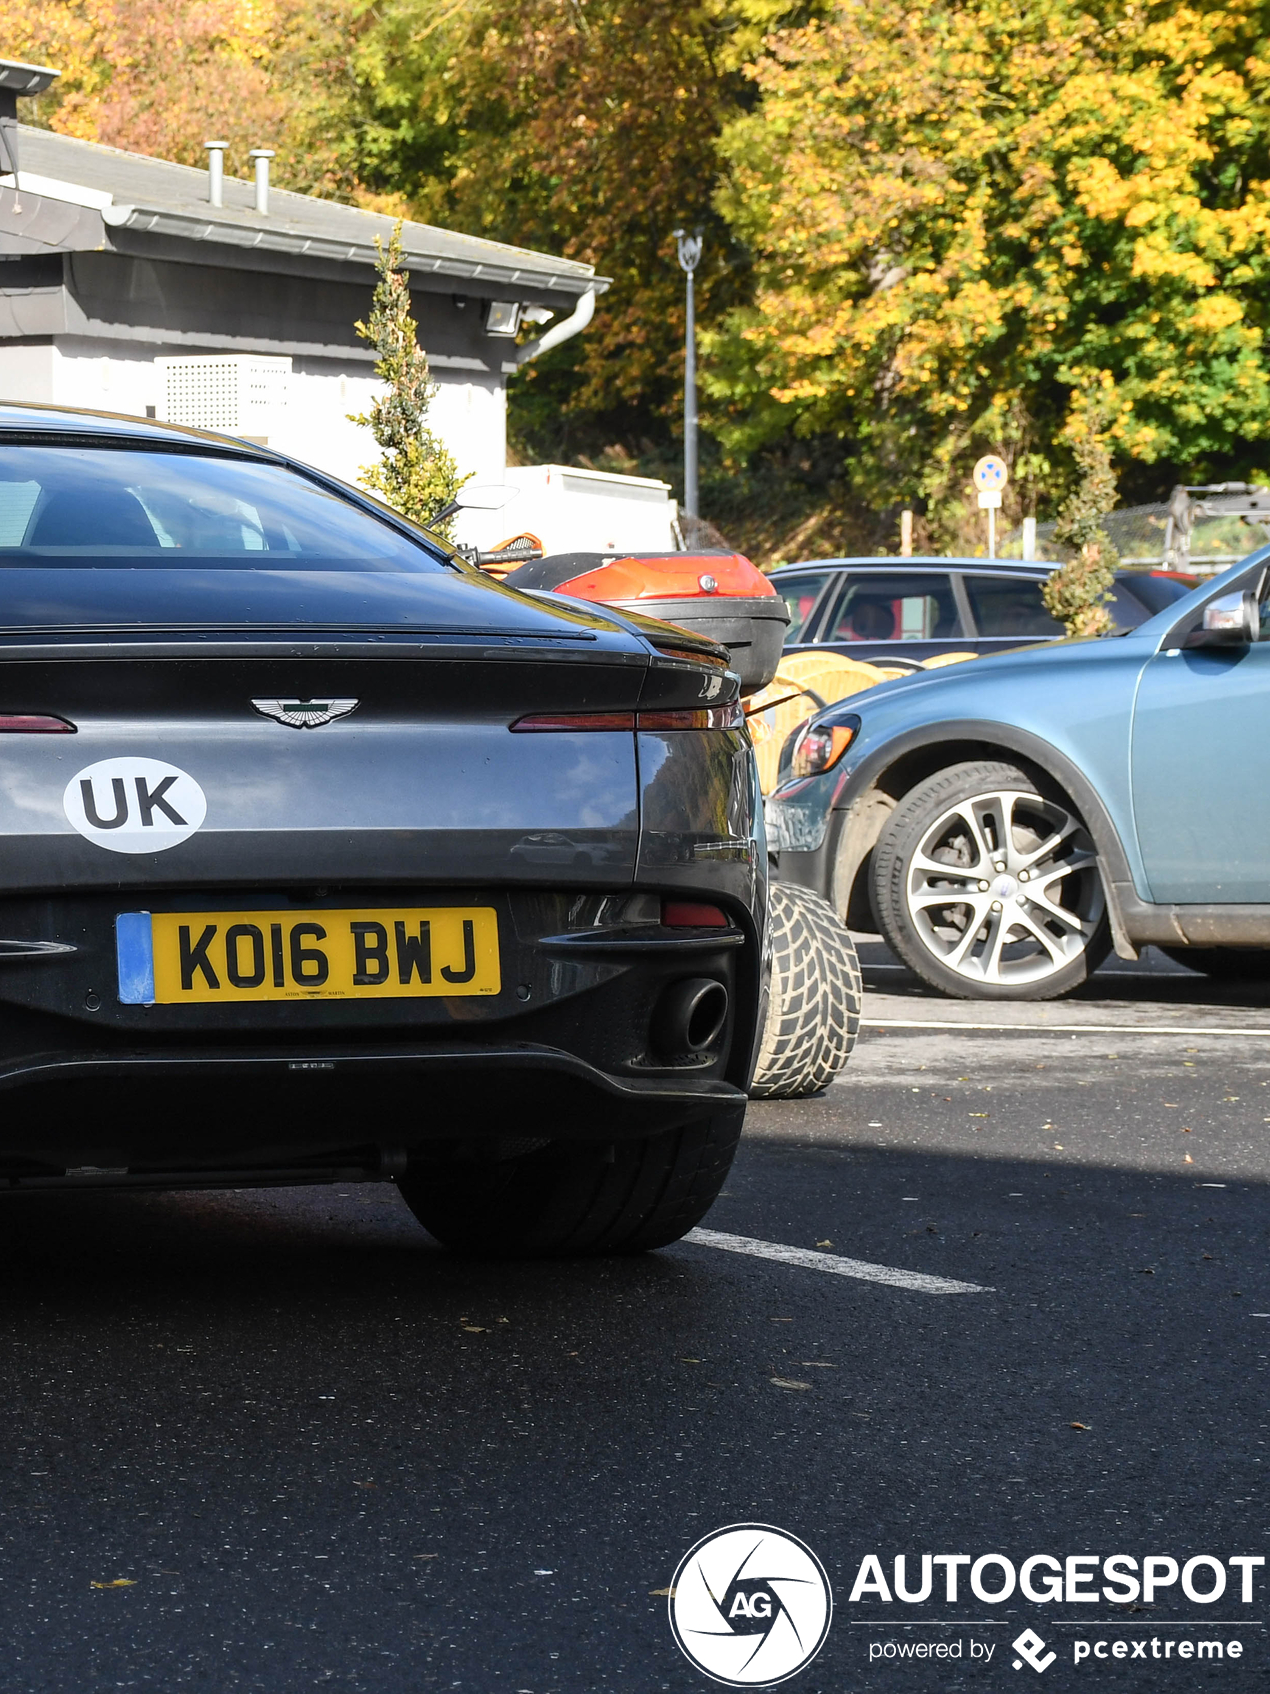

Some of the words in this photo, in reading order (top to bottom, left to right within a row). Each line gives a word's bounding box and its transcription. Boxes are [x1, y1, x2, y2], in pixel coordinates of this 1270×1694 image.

[79, 775, 190, 830] UK
[178, 922, 330, 990] KO16
[349, 919, 476, 986] BWJ
